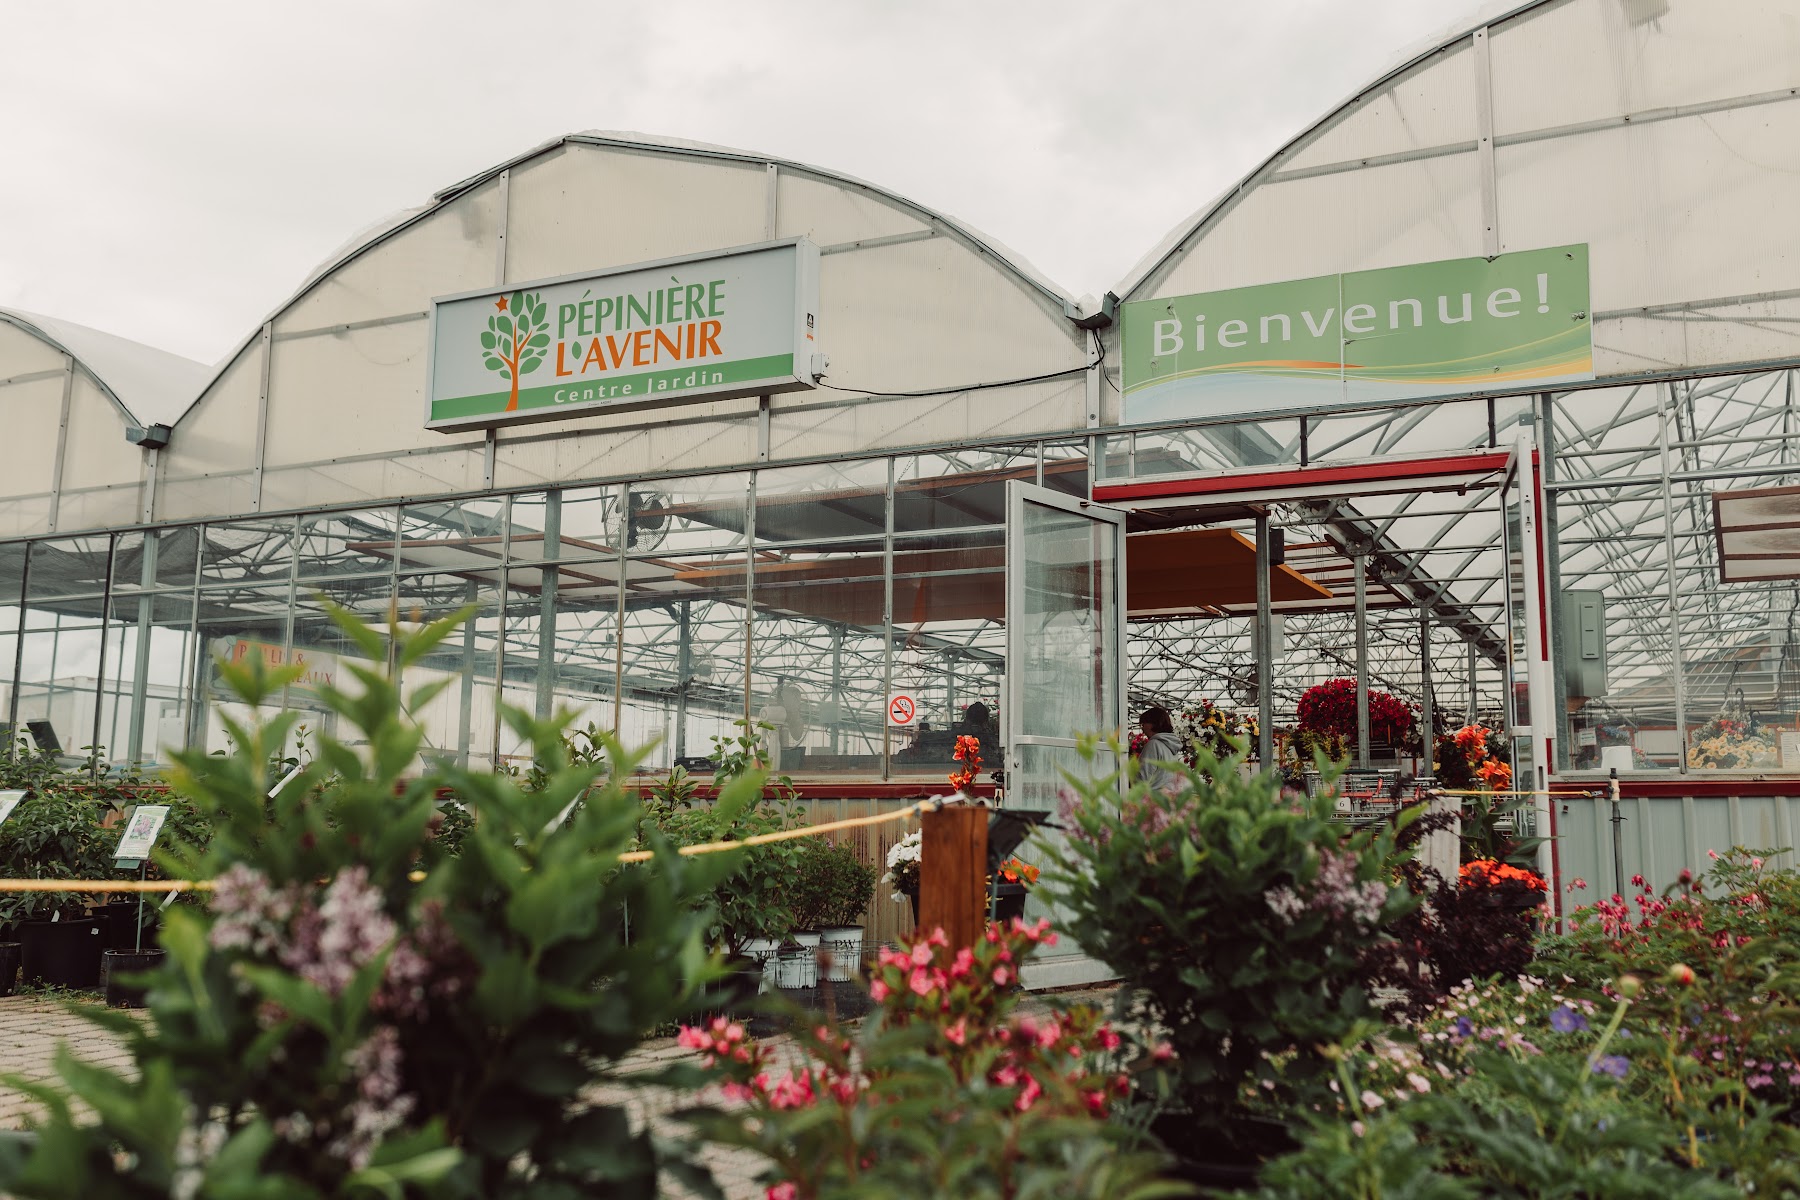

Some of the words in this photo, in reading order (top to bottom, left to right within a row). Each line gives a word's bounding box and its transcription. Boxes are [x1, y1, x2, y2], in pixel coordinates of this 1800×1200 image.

[558, 275, 726, 339] PÉPINIÈRE
[1152, 272, 1551, 357] Bienvenue!
[556, 319, 723, 377] L'AVENIR
[554, 384, 632, 403] Centre
[646, 371, 723, 395] Jardin
